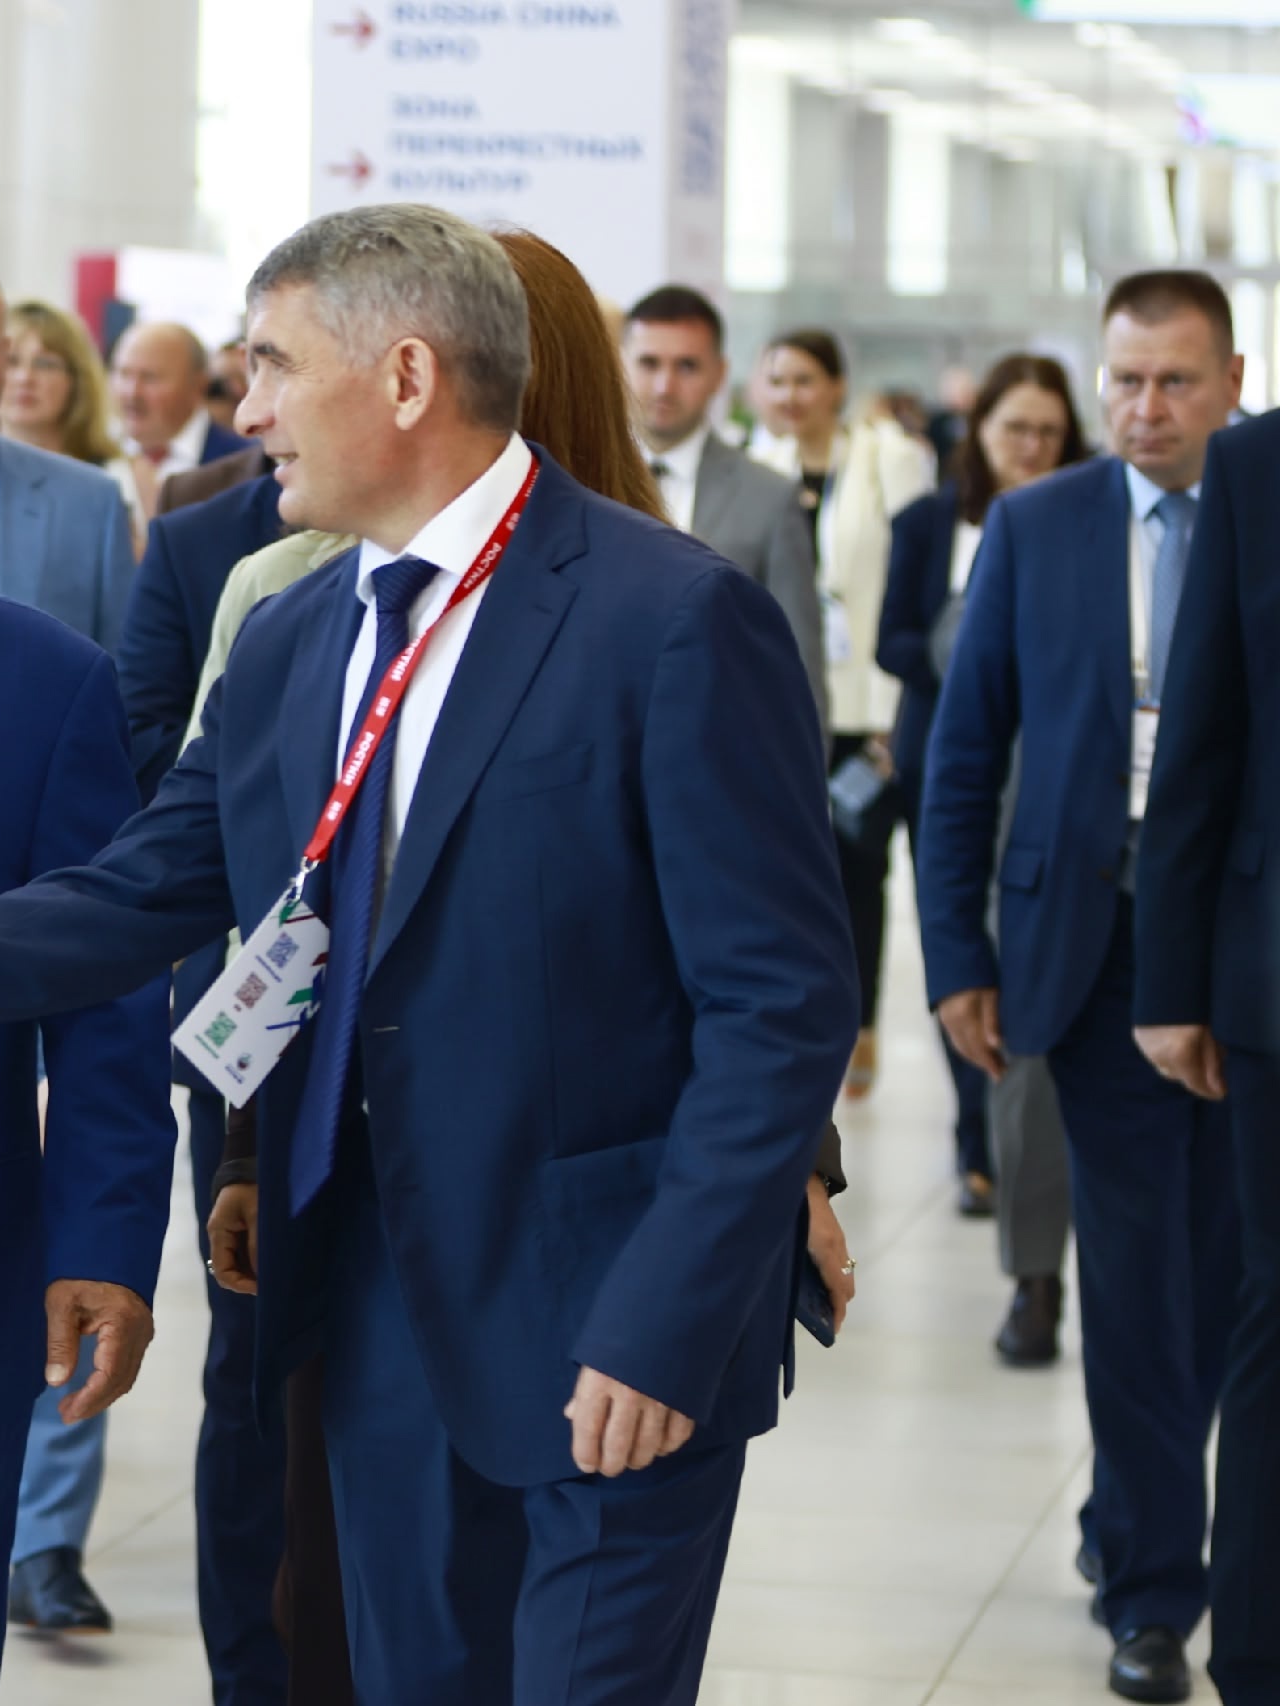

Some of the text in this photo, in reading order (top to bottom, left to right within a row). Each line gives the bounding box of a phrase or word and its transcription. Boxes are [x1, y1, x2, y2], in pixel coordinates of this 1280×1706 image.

[392, 1, 621, 28] RUSSIA CHINA
[391, 36, 478, 61] EXPO
[392, 94, 479, 119] ЗОНА
[391, 168, 529, 193] КУЛЬТУР
[463, 541, 502, 589] РОСТКИ
[342, 731, 375, 786] РОСТКИ
